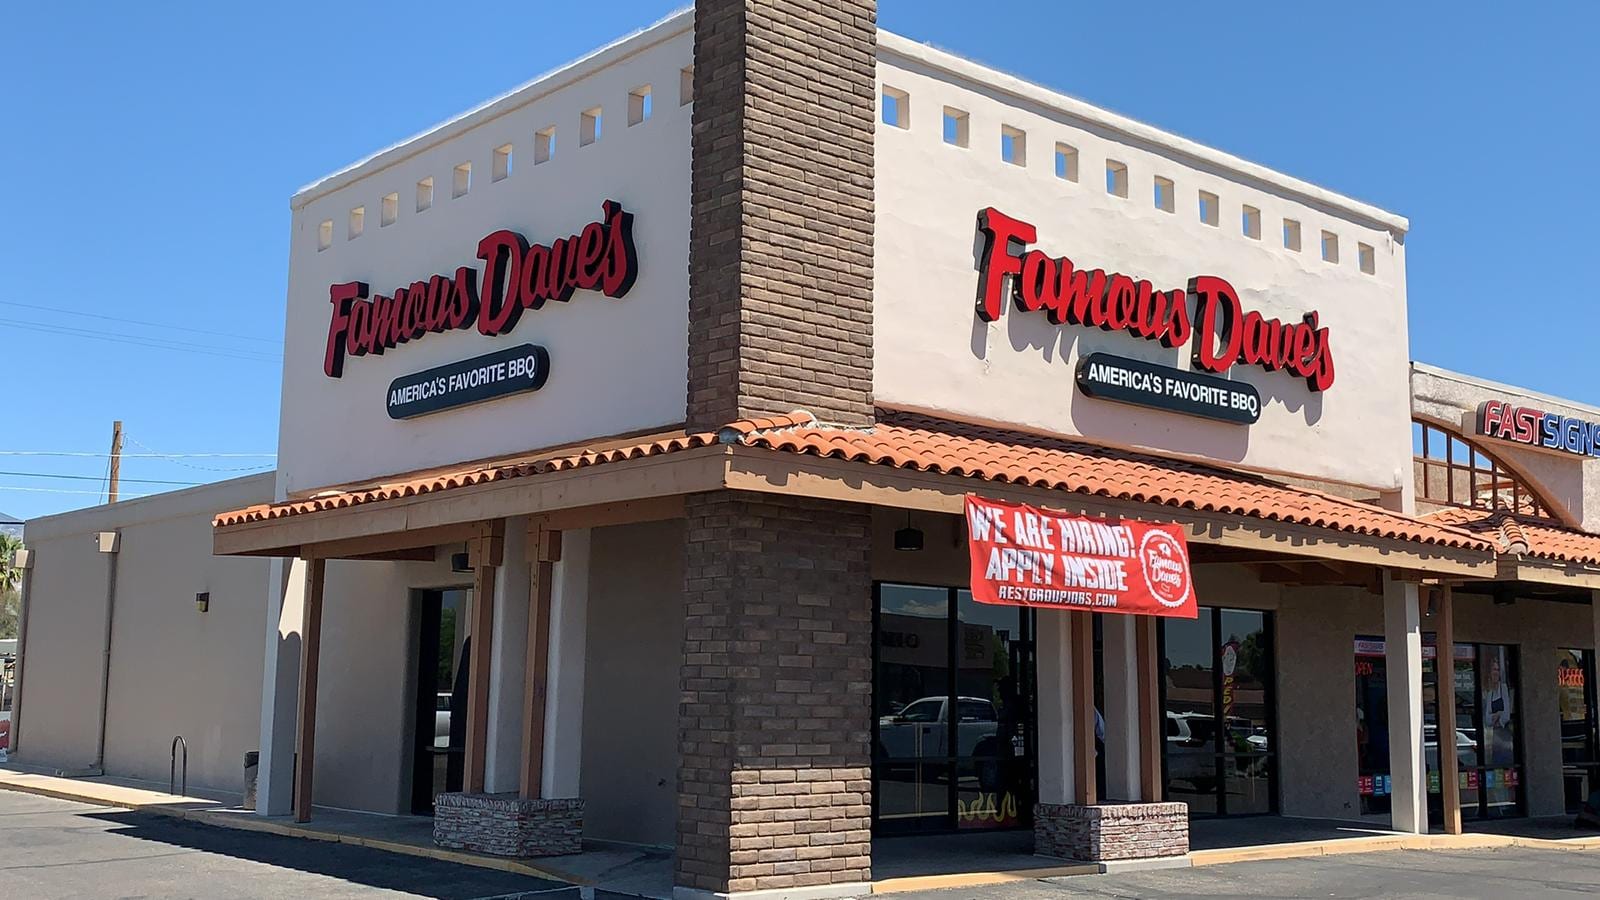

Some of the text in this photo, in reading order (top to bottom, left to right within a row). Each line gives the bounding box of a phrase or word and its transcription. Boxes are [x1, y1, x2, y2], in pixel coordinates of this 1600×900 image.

[324, 199, 638, 378] Famous Dave's
[976, 206, 1335, 392] Famous Dave's
[389, 355, 536, 407] AMERICA'S FAVORITE BBQ
[1088, 363, 1258, 417] AMERICA'S FAVORITE BBQ
[968, 503, 1008, 544] WE
[1013, 511, 1055, 550] ARE
[1058, 518, 1136, 559] HIRING!
[985, 547, 1129, 592] APPLY INSIDE
[998, 585, 1118, 607] RESTGROUPJOBS.COM
